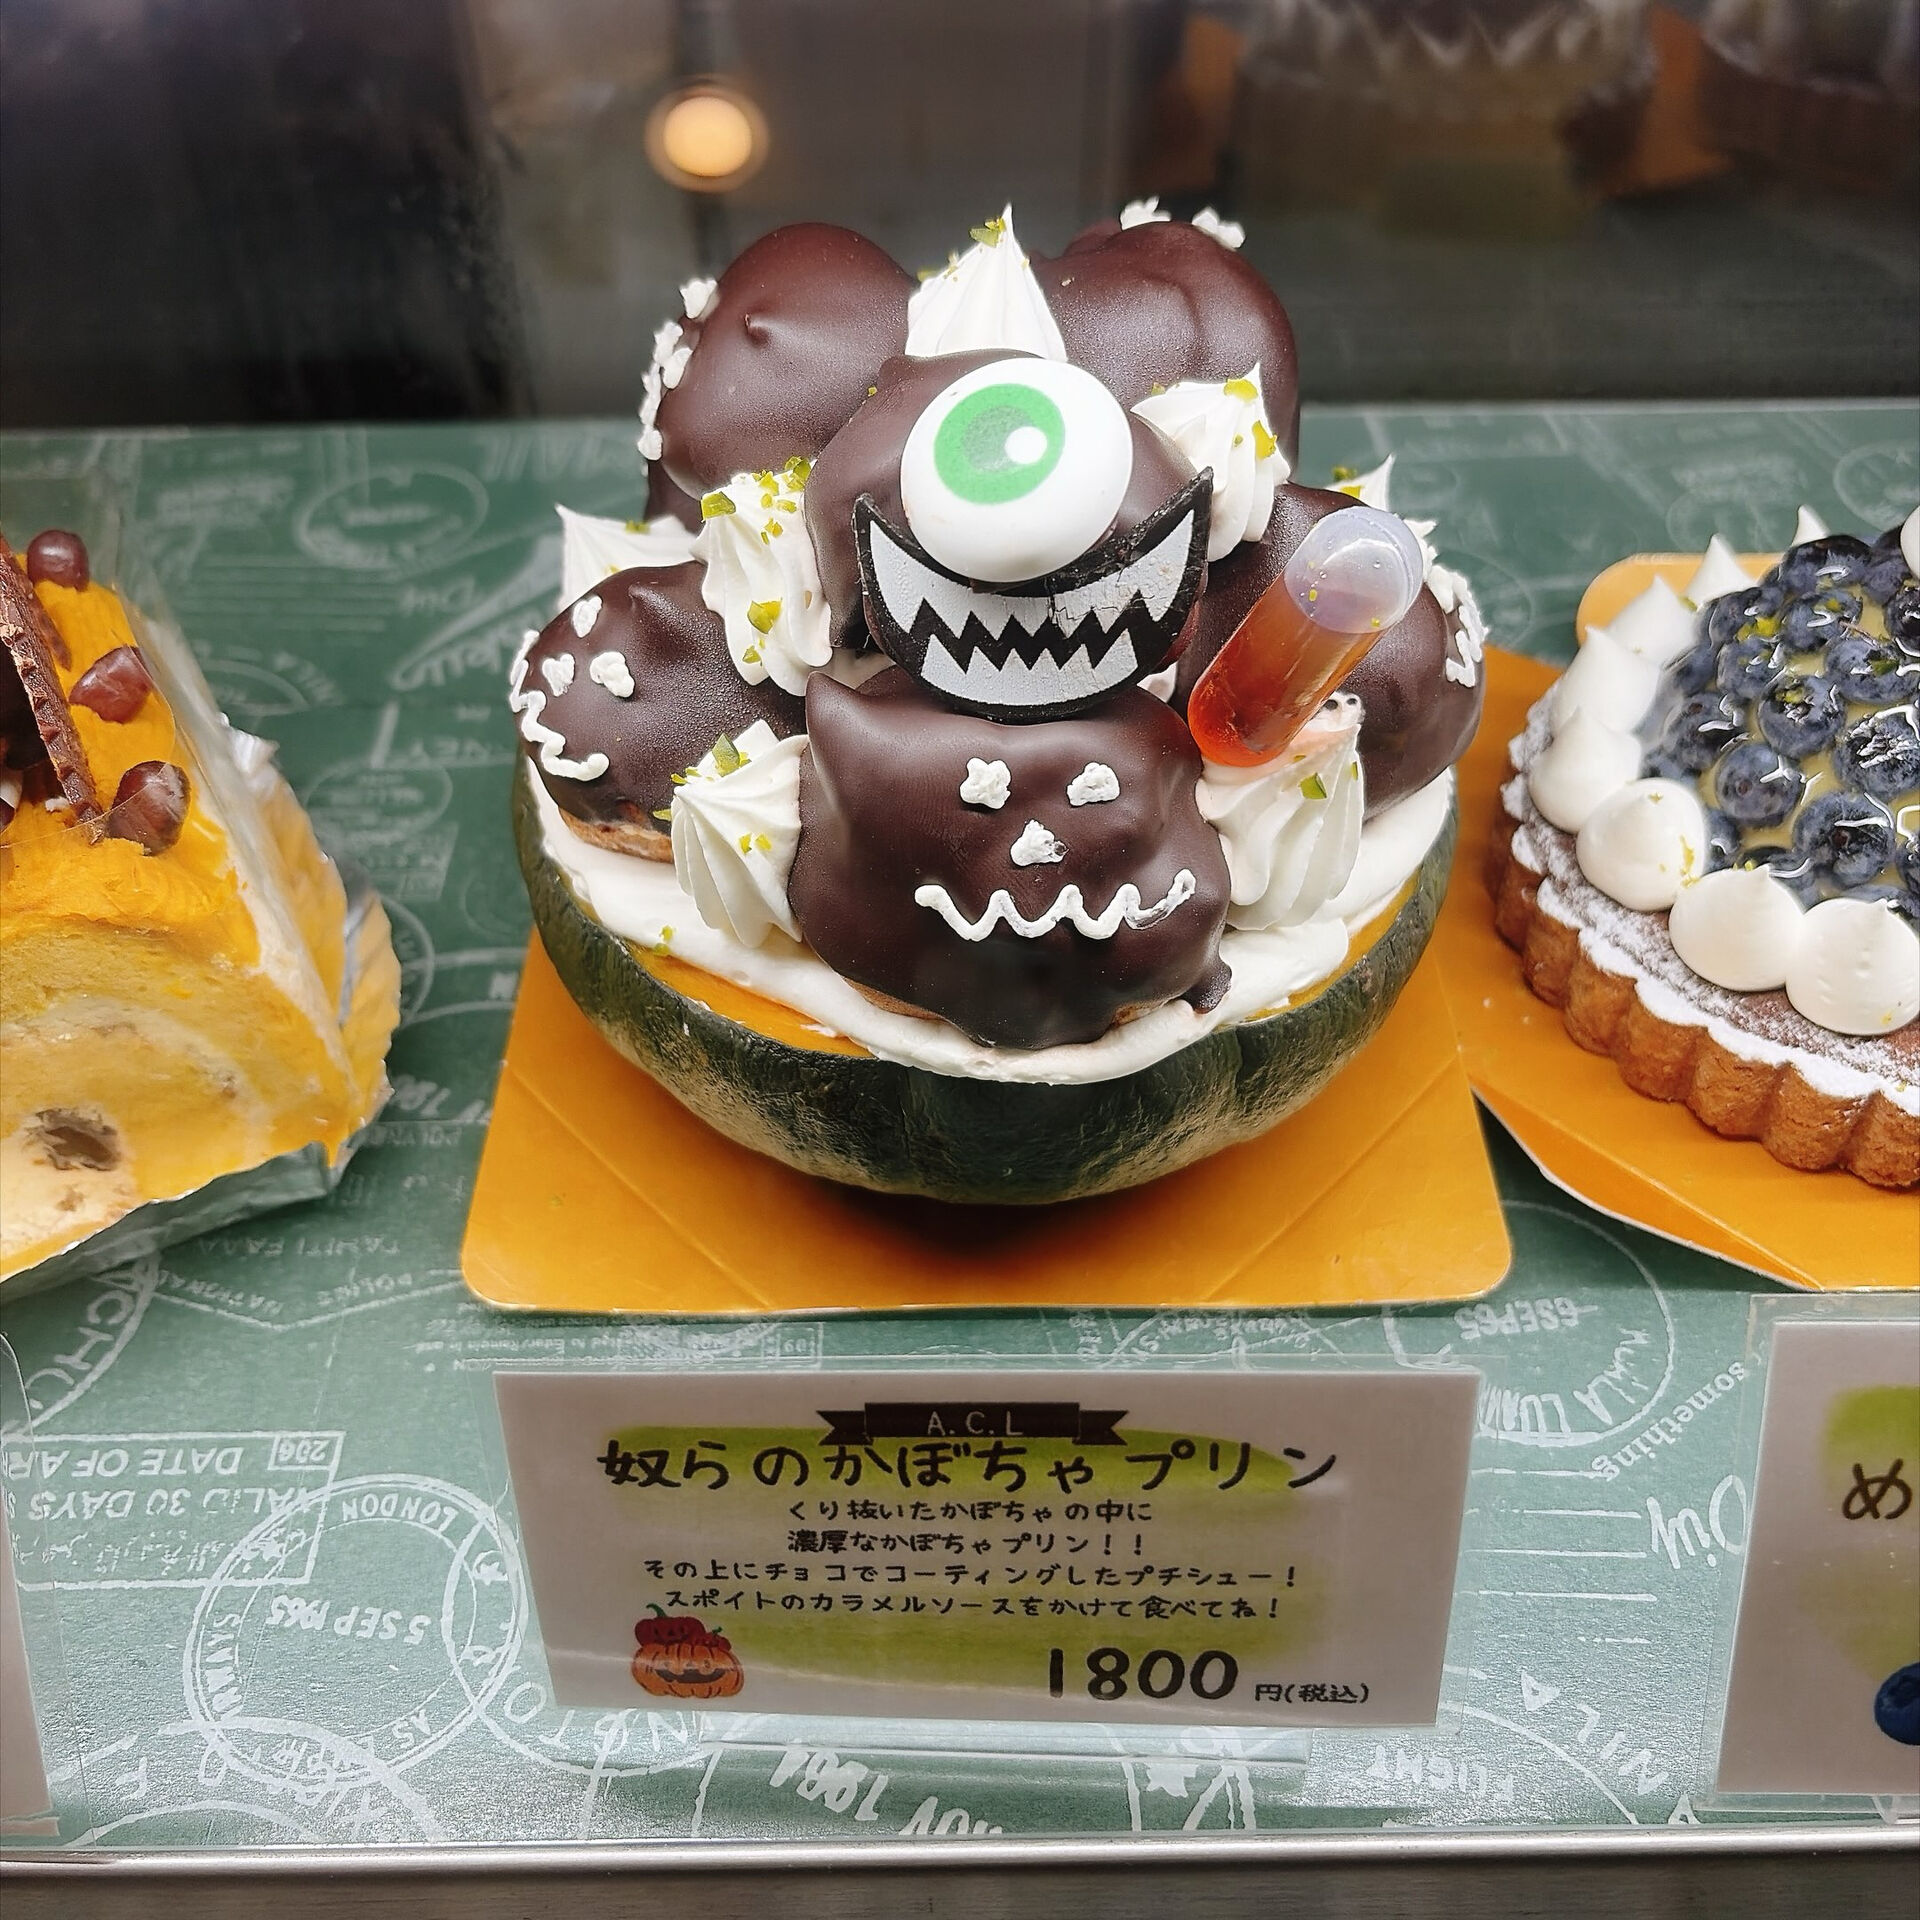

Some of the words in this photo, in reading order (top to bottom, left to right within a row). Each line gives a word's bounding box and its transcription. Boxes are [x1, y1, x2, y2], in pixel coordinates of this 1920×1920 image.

[1589, 1361, 1747, 1483] something
[71, 1447, 130, 1478] OF
[136, 1445, 245, 1477] DATE
[597, 1438, 1337, 1494] 奴らのかぼちゃプリン
[28, 1489, 136, 1521] DAYS
[1843, 1457, 1914, 1521] め
[341, 1492, 460, 1535] LONDON
[788, 1498, 1153, 1524] くり抜いたかぼちゃの中に
[1049, 1646, 1240, 1700] 1800
[1254, 1683, 1370, 1704] 円(税込)
